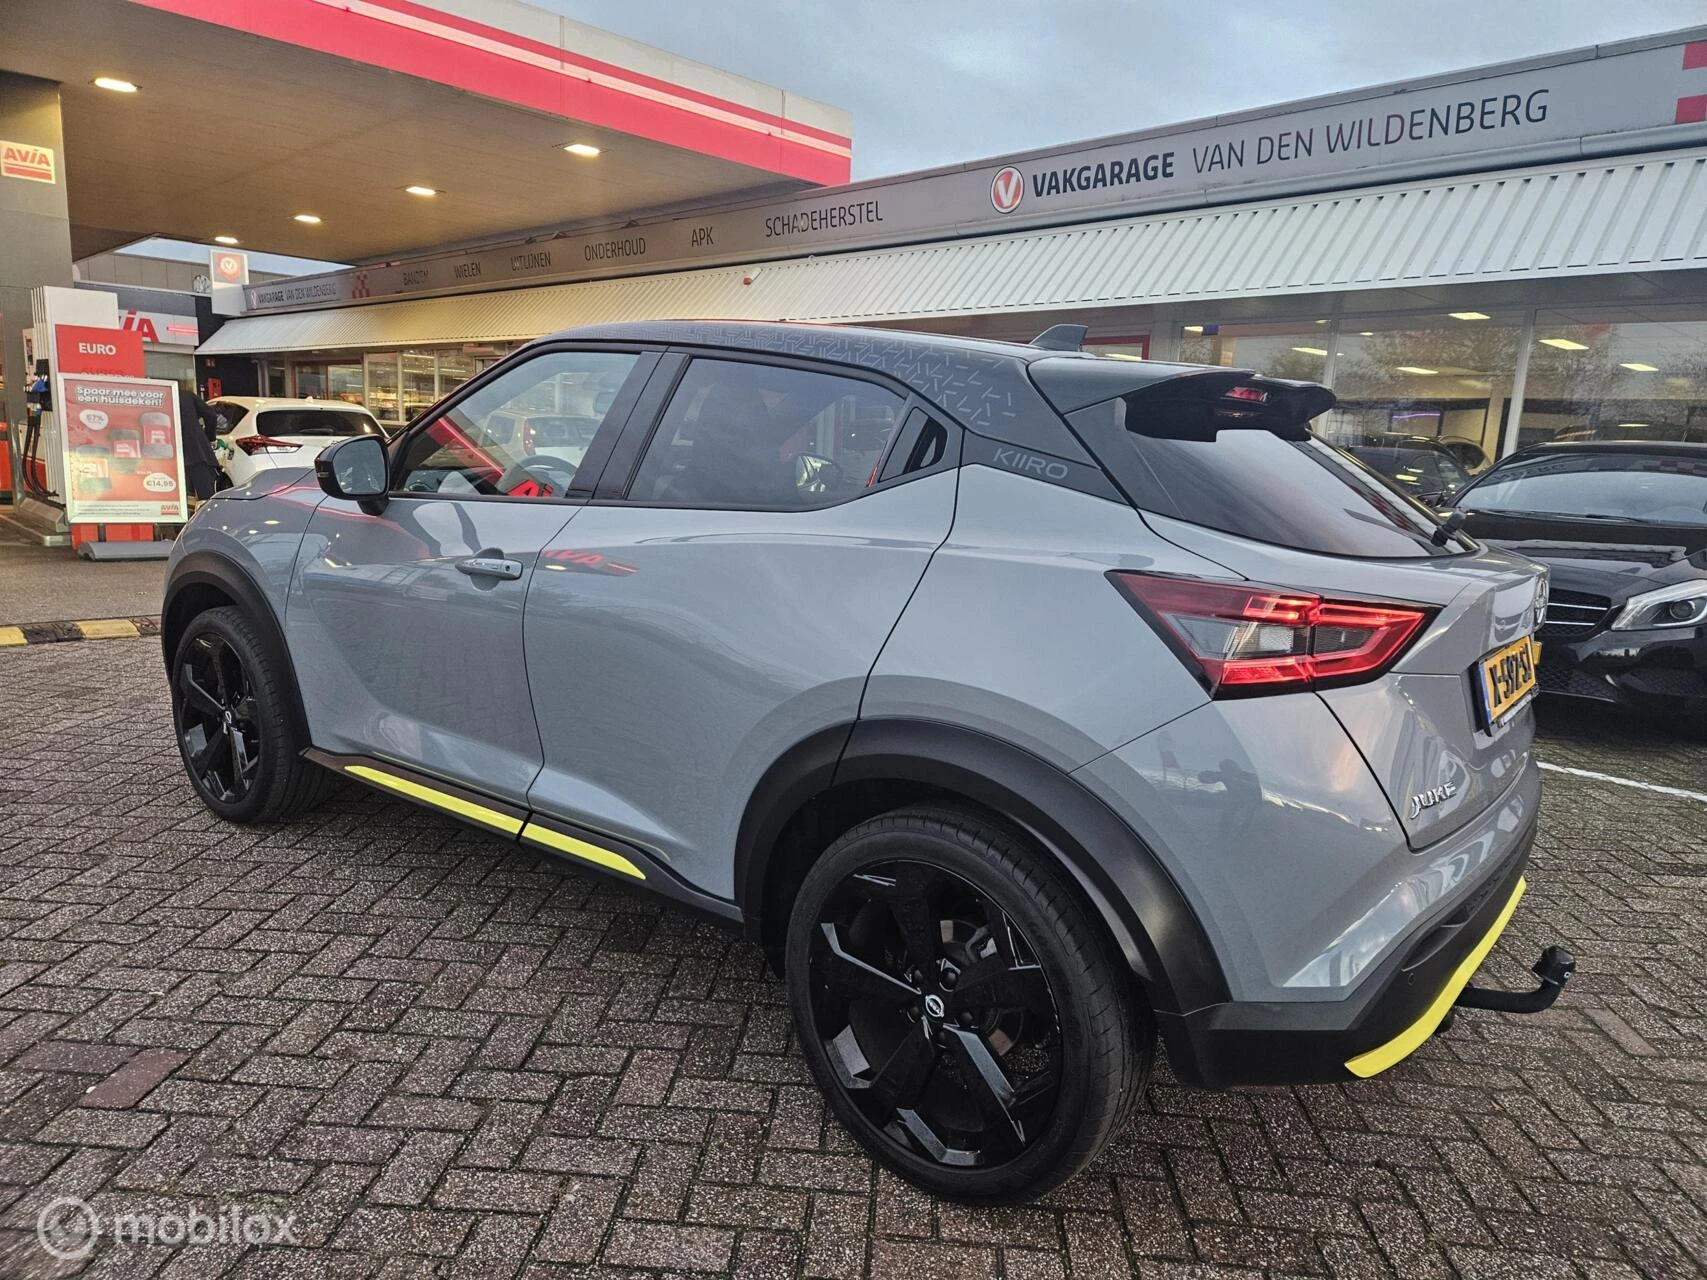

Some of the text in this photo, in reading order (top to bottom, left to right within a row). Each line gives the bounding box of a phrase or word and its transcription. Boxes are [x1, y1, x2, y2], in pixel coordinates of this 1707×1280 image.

[1033, 89, 1549, 197] VAKGARAGE VAN DEN WILDENBERG
[5, 148, 51, 166] AVIA
[765, 201, 883, 237] SCHADEHERSTEL
[691, 227, 714, 247] APK
[584, 237, 646, 261] ONDERHOUD
[454, 261, 482, 279] WIELEN
[78, 342, 117, 356] EURO
[77, 386, 165, 399] Spaar mee voor
[101, 394, 163, 407] huisdeken!
[993, 447, 1069, 480] KIIRO
[1409, 781, 1458, 820] JUKE
